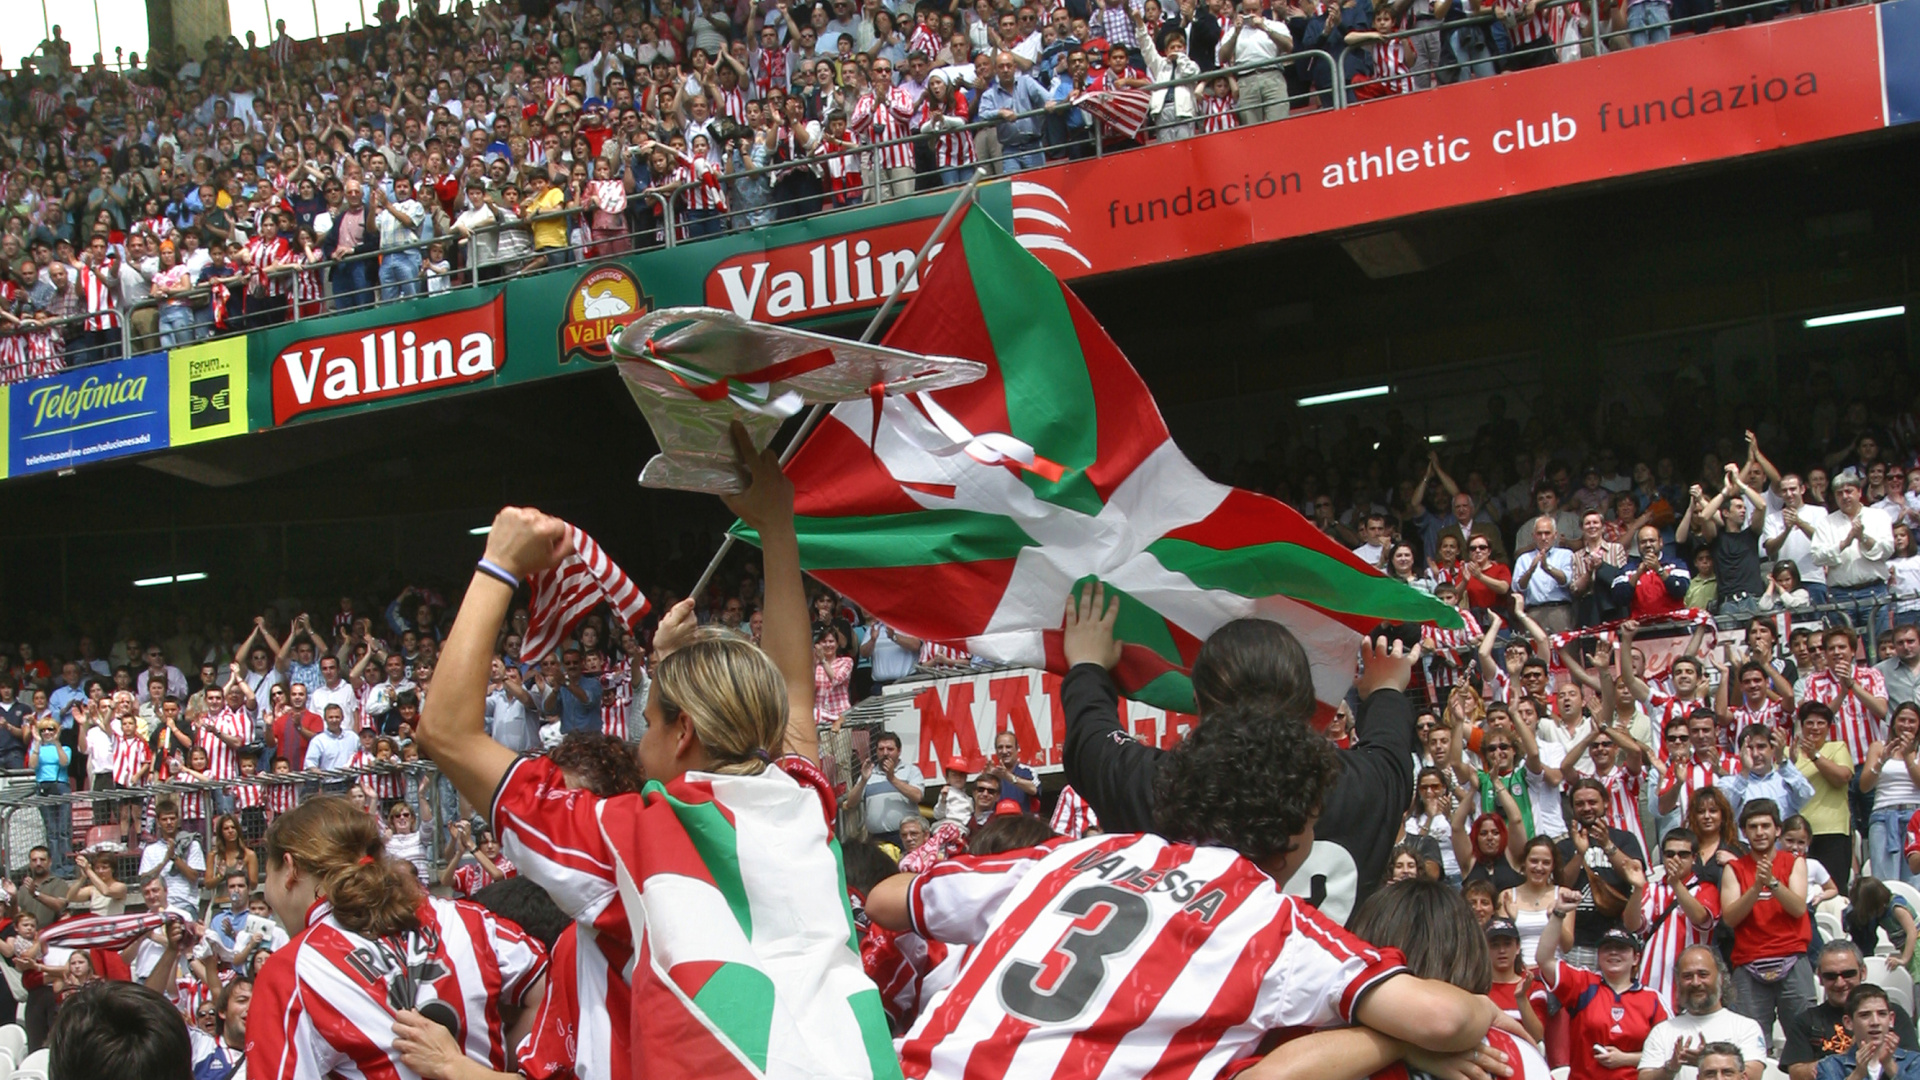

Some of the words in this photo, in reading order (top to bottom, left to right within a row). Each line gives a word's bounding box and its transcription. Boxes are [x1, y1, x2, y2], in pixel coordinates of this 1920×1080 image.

[1108, 170, 1302, 229] fundación
[1321, 133, 1471, 189] athletic
[1491, 111, 1578, 155] club
[1597, 71, 1819, 133] fundazioa
[189, 357, 220, 371] Forum
[281, 329, 496, 405] Vallina
[1072, 850, 1227, 924] VANESSA
[995, 884, 1154, 1026] 3
